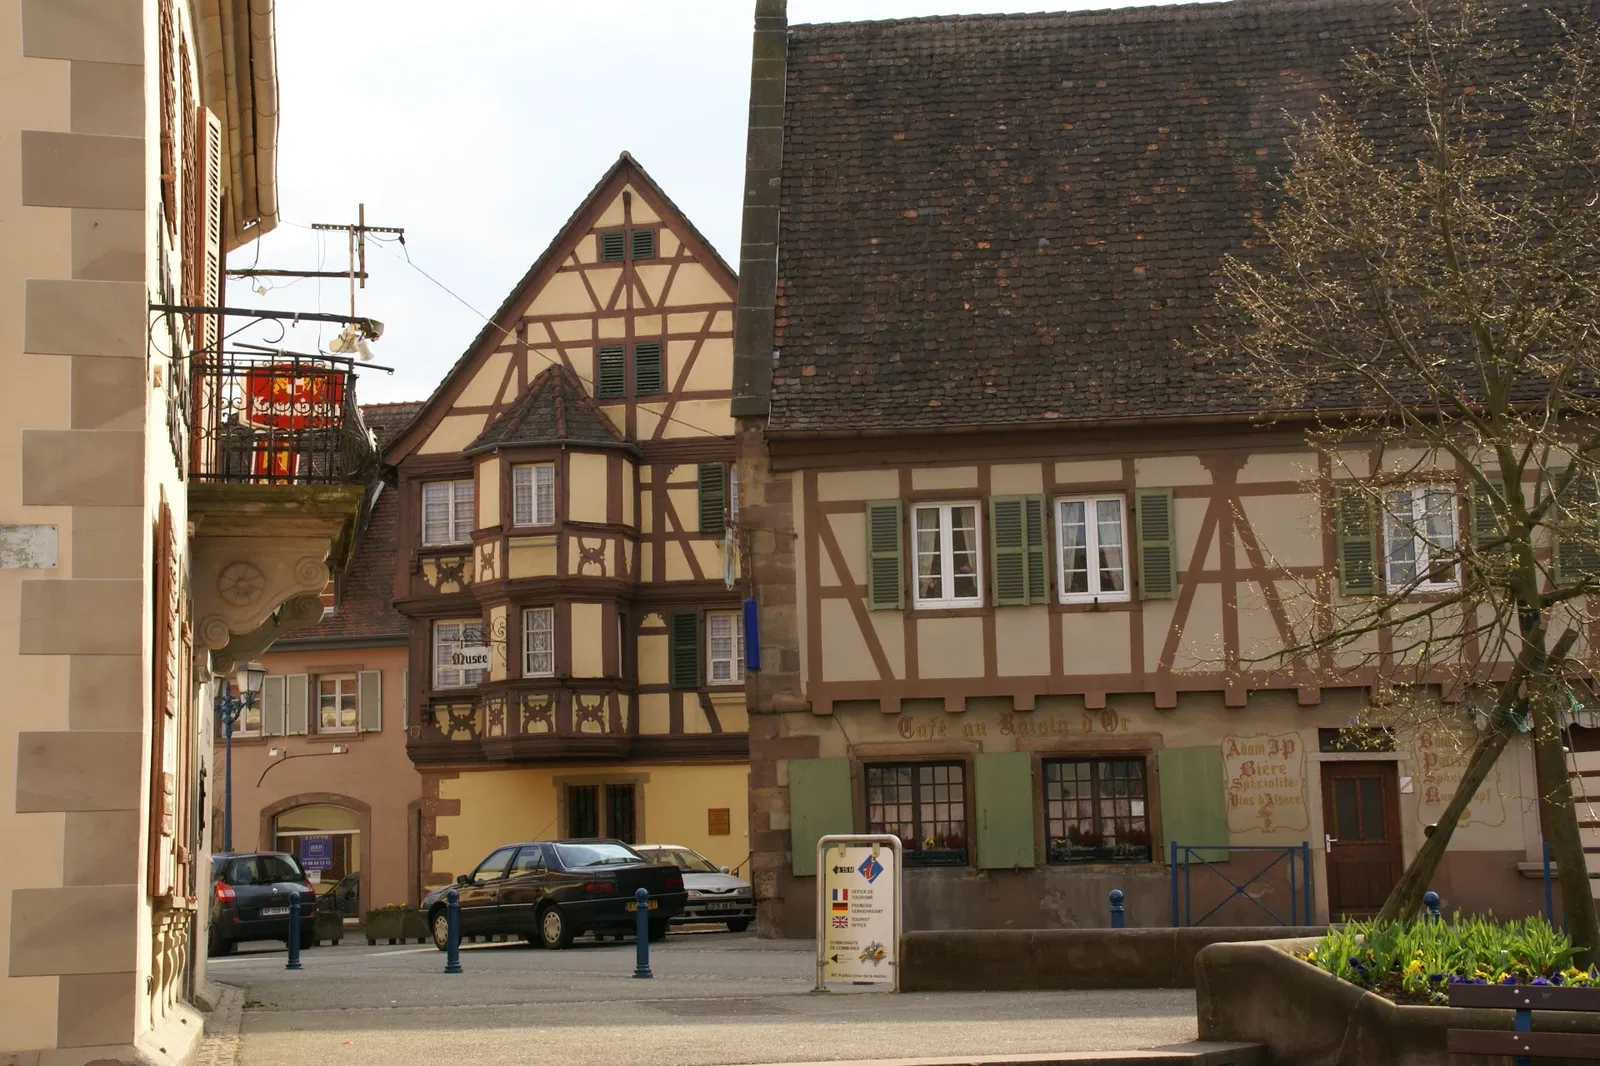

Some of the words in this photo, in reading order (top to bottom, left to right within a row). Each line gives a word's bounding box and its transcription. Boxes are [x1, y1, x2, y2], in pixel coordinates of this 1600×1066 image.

[898, 715, 947, 740] Café
[963, 721, 988, 737] au
[1227, 739, 1265, 759] Adam
